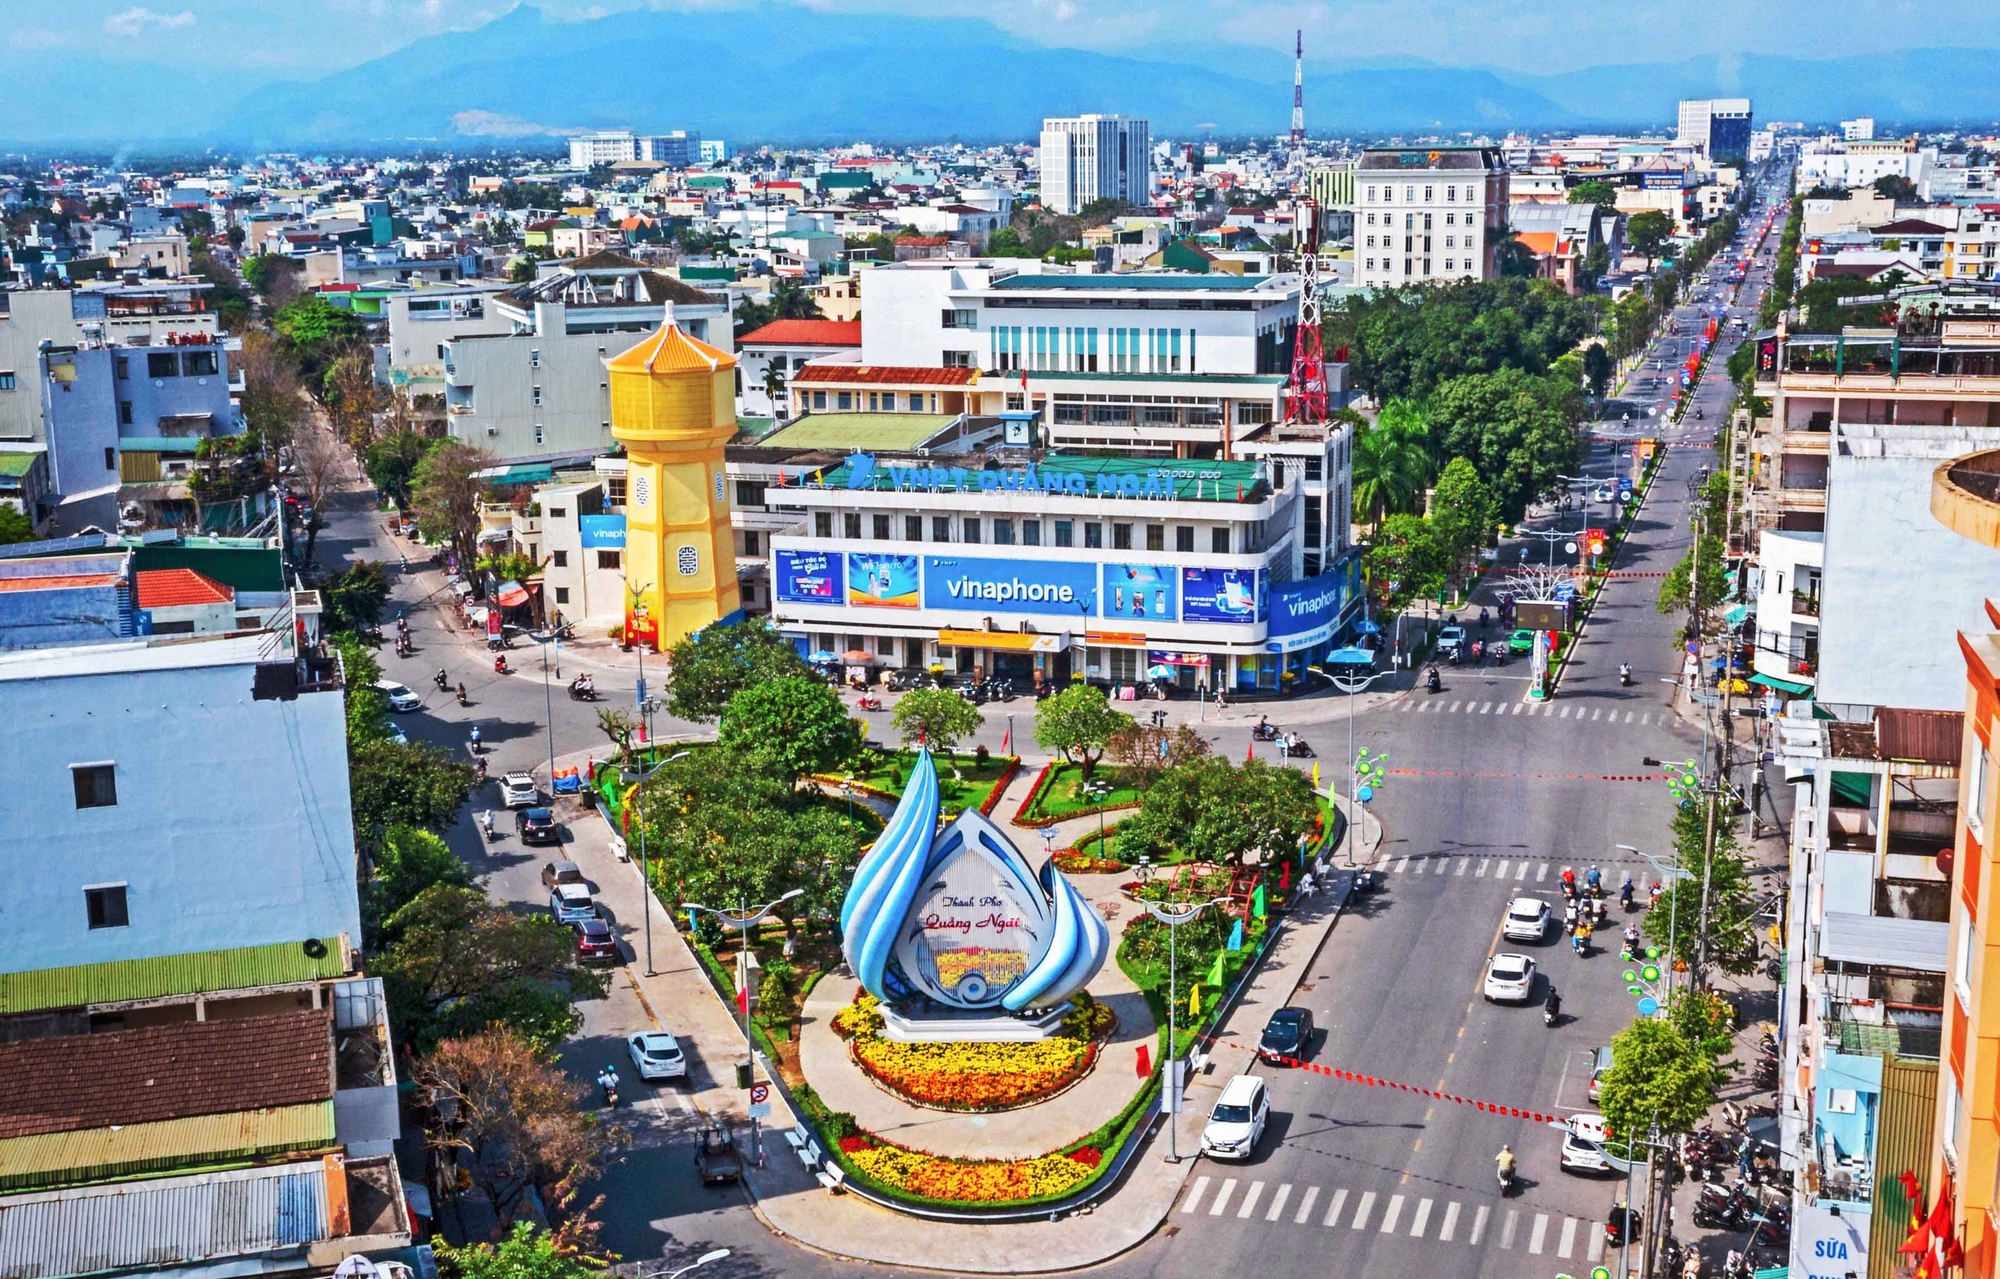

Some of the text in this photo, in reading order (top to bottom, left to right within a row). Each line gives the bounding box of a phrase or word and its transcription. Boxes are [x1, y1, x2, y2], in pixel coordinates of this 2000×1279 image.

[1399, 151, 1427, 164] BIDV
[888, 466, 968, 489] VNPT
[978, 462, 1087, 494] QUẢNG
[947, 575, 1074, 603] vinaphone
[922, 913, 971, 934] Quảng
[1815, 1237, 1848, 1260] SỮA
